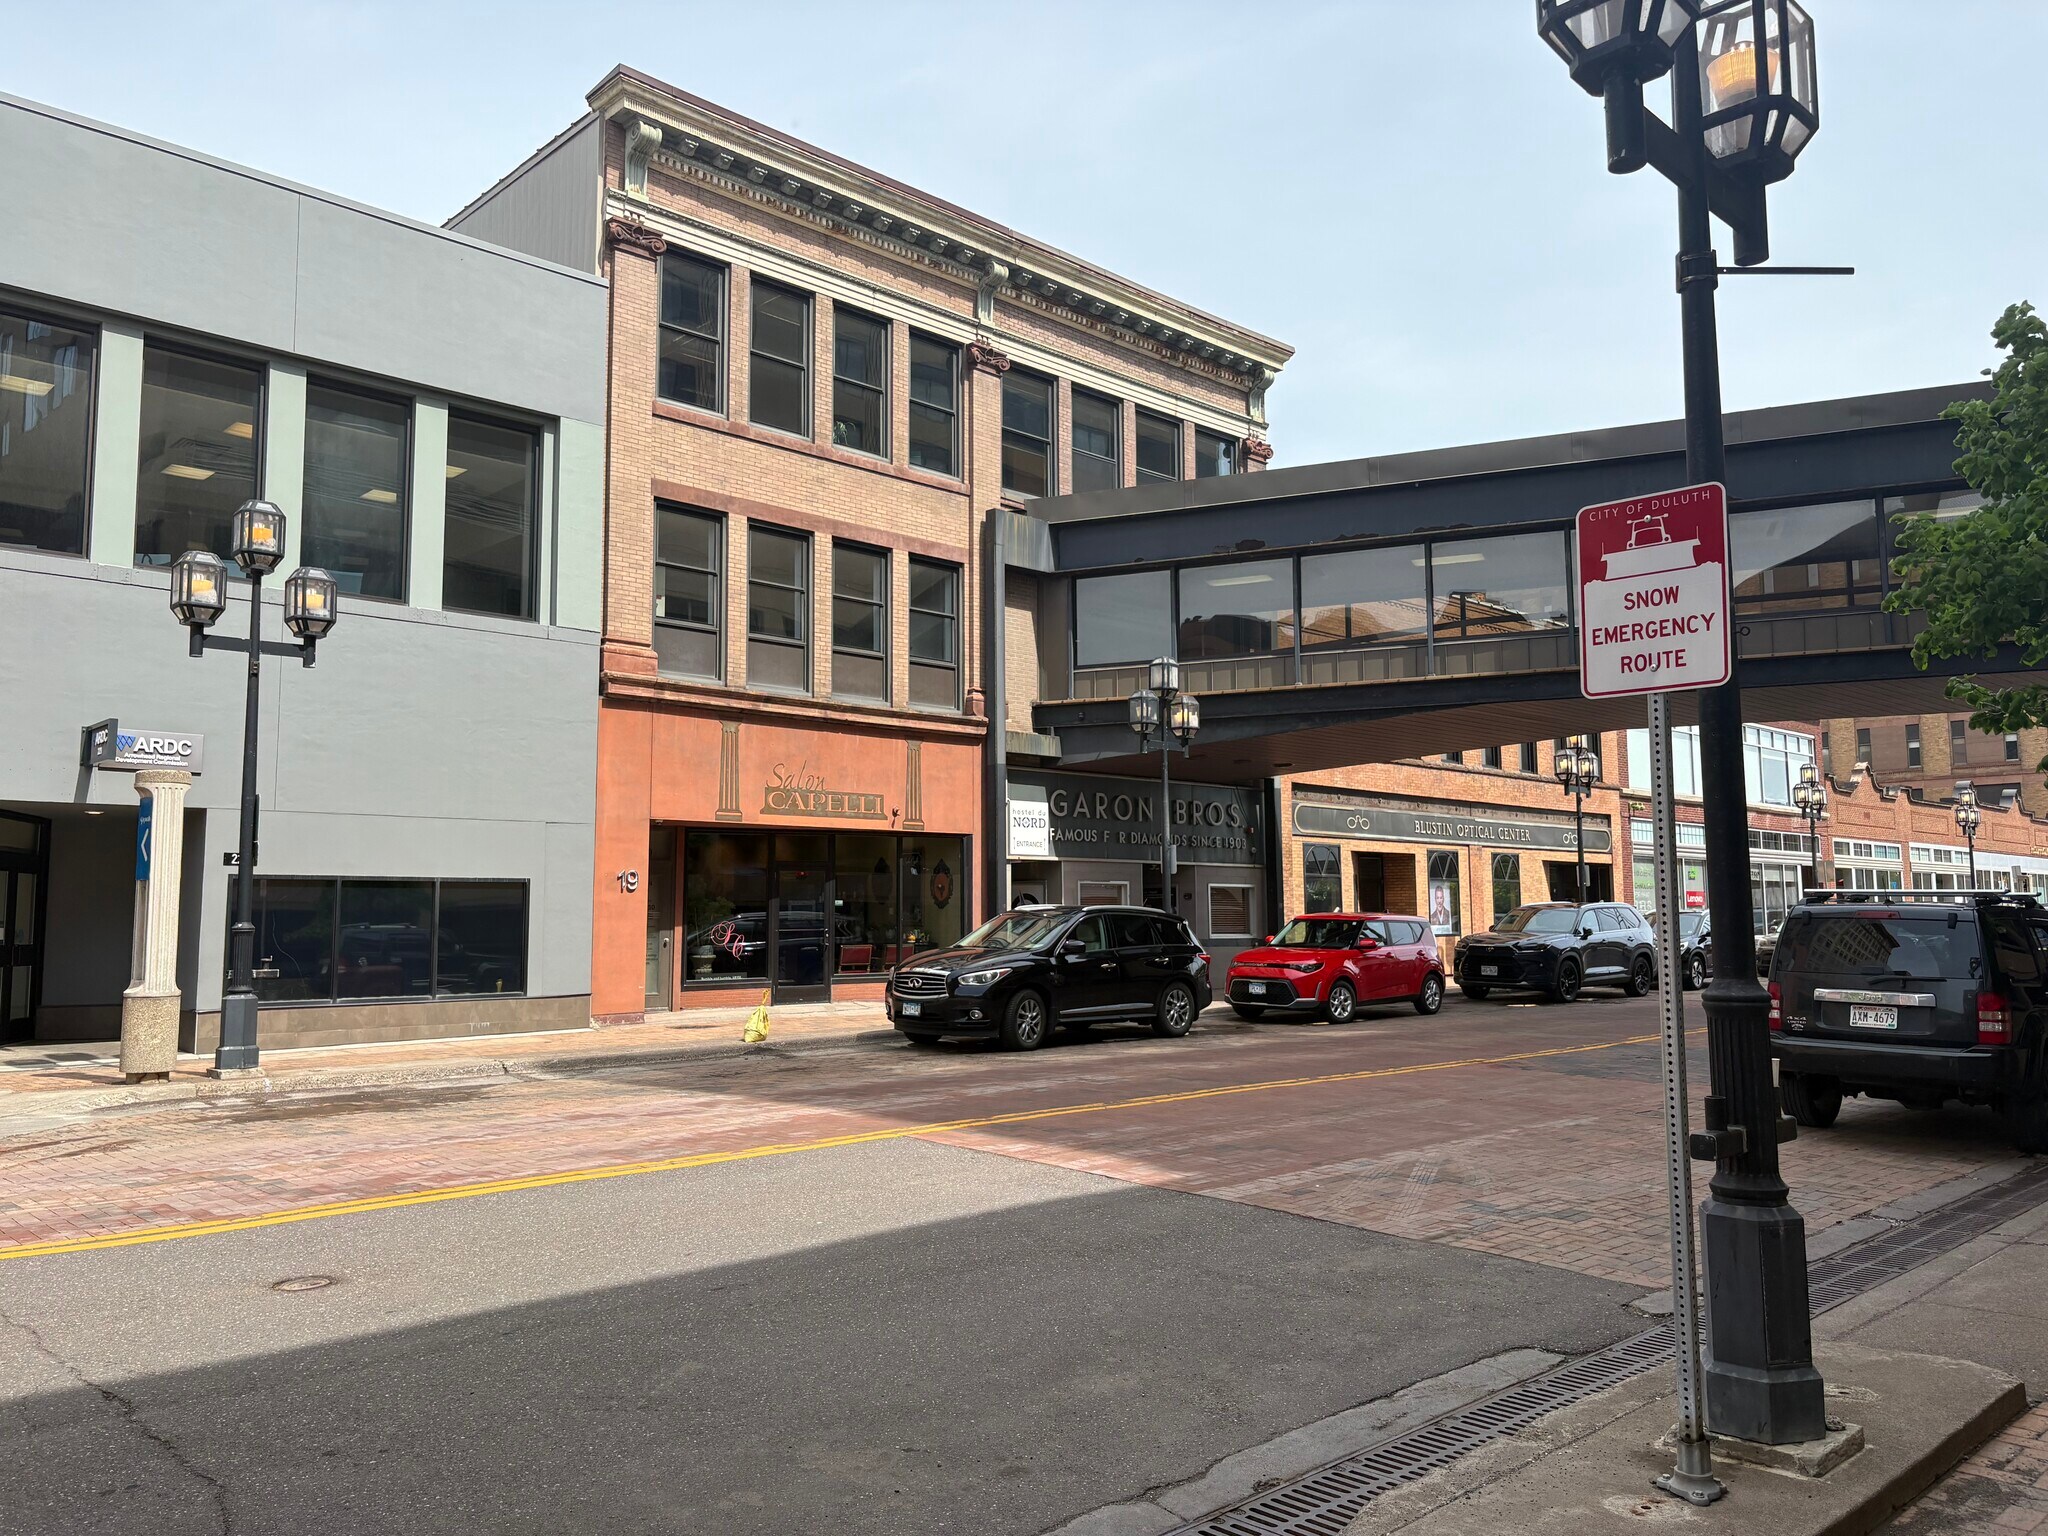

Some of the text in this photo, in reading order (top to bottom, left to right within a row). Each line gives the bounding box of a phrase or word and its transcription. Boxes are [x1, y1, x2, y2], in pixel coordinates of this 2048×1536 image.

[1589, 490, 1710, 522] CITY OF DULUTH
[1623, 585, 1679, 611] SNOW
[1592, 612, 1716, 646] EMERGENCY
[1620, 649, 1687, 674] ROUTE
[133, 736, 193, 757] ARDC
[766, 760, 826, 791] Salon
[768, 791, 882, 814] CAPELLI
[1012, 808, 1035, 816] hostel
[1050, 789, 1153, 822] GARON
[1013, 816, 1047, 829] NORD
[1414, 820, 1532, 842] BLUSTIN OPTICAL CENTER
[1016, 840, 1043, 848] ENTRANCE
[1050, 828, 1097, 842] FAMOUS
[1192, 835, 1221, 849] SINCE
[616, 869, 639, 893] 19
[1687, 894, 1704, 903] Lenovo
[1852, 1011, 1896, 1025] AXM-4679
